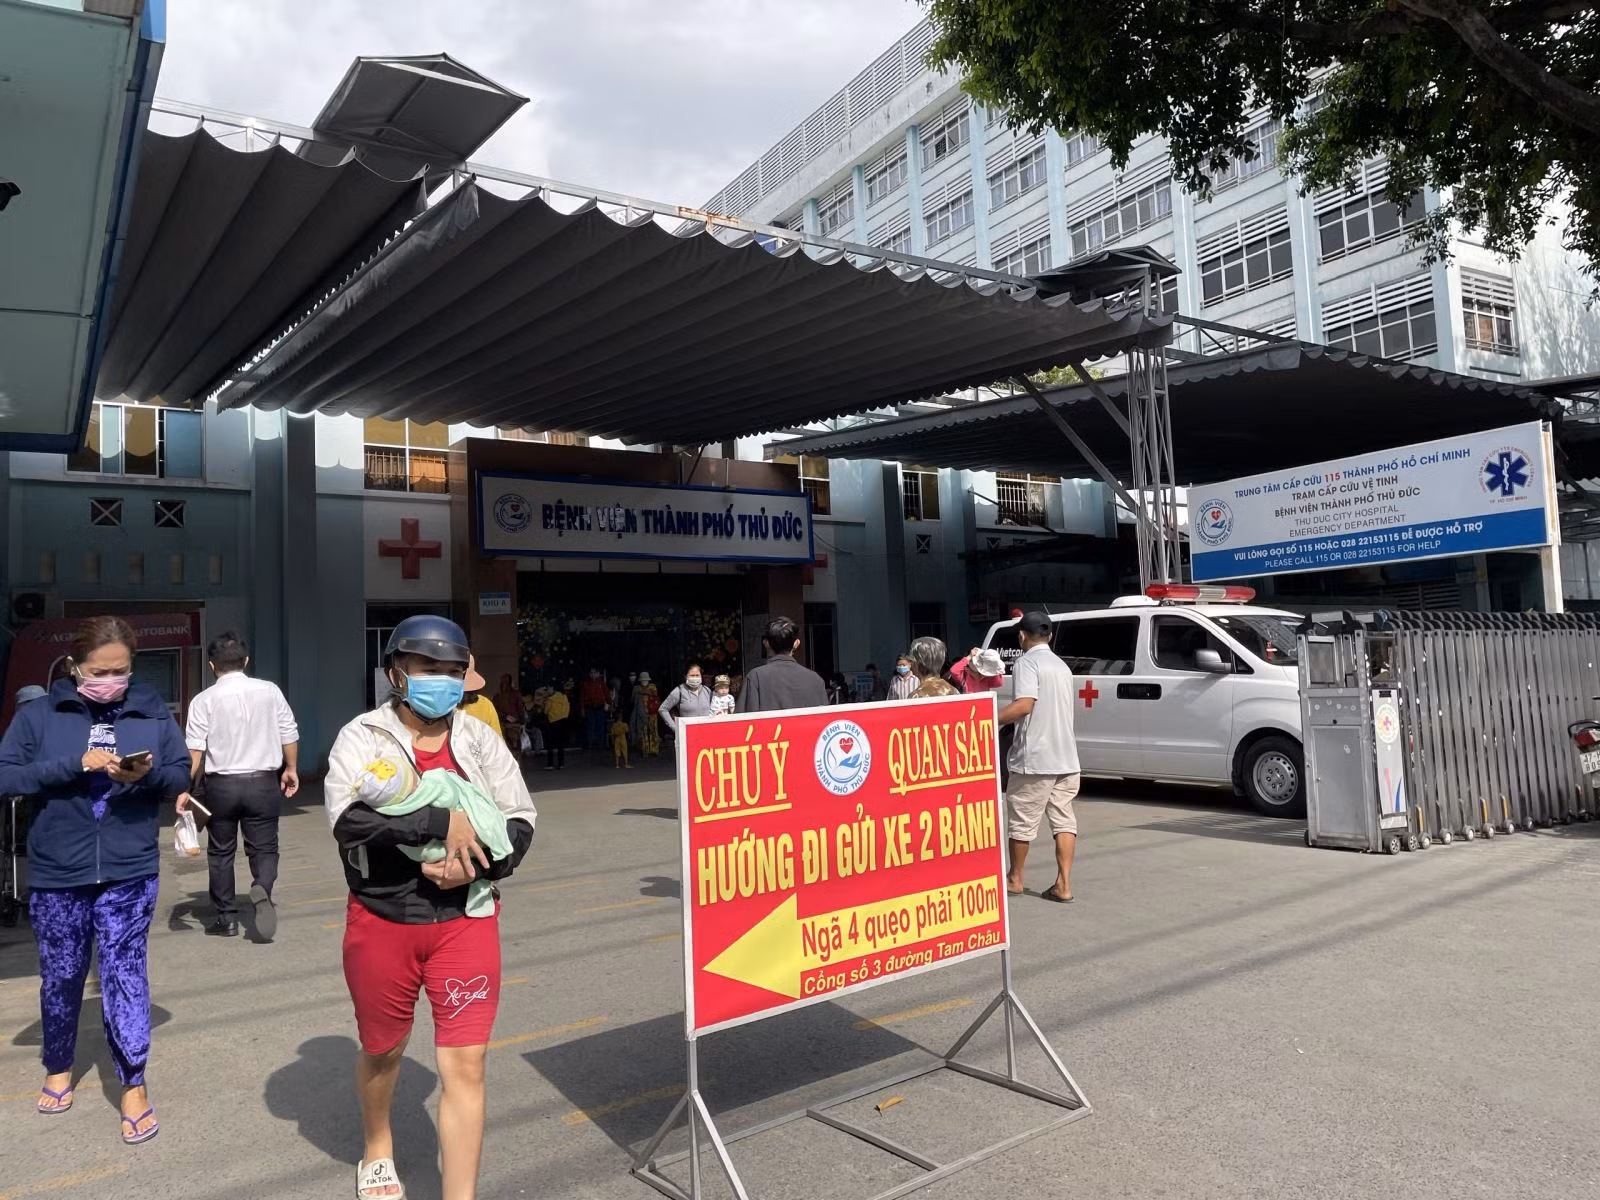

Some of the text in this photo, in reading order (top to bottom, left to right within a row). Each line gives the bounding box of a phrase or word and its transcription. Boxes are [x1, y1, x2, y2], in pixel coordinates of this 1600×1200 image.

[1235, 448, 1471, 498] TRUNG TÂM CẤP CỨU 115 THÀNH PHỐ HỒ CHÍ MINH
[1292, 475, 1399, 502] TRẠM CẤP CỨU VỆ TINH
[542, 498, 592, 537] BỆNH
[596, 502, 638, 539] VIỆN
[642, 504, 699, 536] THÀNH
[702, 504, 735, 537] PHỐ
[738, 507, 769, 539] THỦ
[1274, 486, 1421, 519] BỆNH VIỆN THÀNH PHỐ THỦ ĐỨC
[1294, 504, 1399, 527] THU DUC CITY HOSPITAL
[1234, 551, 1247, 561] VUI
[1248, 546, 1268, 559] LÒNG
[1269, 548, 1285, 559] GỌI
[1286, 543, 1297, 554] SỐ
[1299, 543, 1314, 553] 115
[1315, 540, 1339, 552] HOẶC
[1341, 537, 1356, 548] 028
[1358, 534, 1399, 547] 22153115
[1463, 520, 1483, 533] TRỢ
[1289, 514, 1406, 538] EMERGENCY DEPARTMENT
[1265, 540, 1441, 568] PLEASE CALL 115 OR 028 22153115 FOR HELP
[695, 723, 790, 812] CHÚ Ý
[888, 706, 994, 796] QUAN SÁT
[816, 758, 832, 787] THÀNH
[833, 783, 848, 794] PHỐ
[698, 793, 997, 906] HƯỚNG ĐI GỬI XE 2 BÁNH
[801, 884, 998, 962] Ngã 4 quẹo phải 100m
[804, 930, 1001, 995] Cổng số 3 đường Tam Châu
